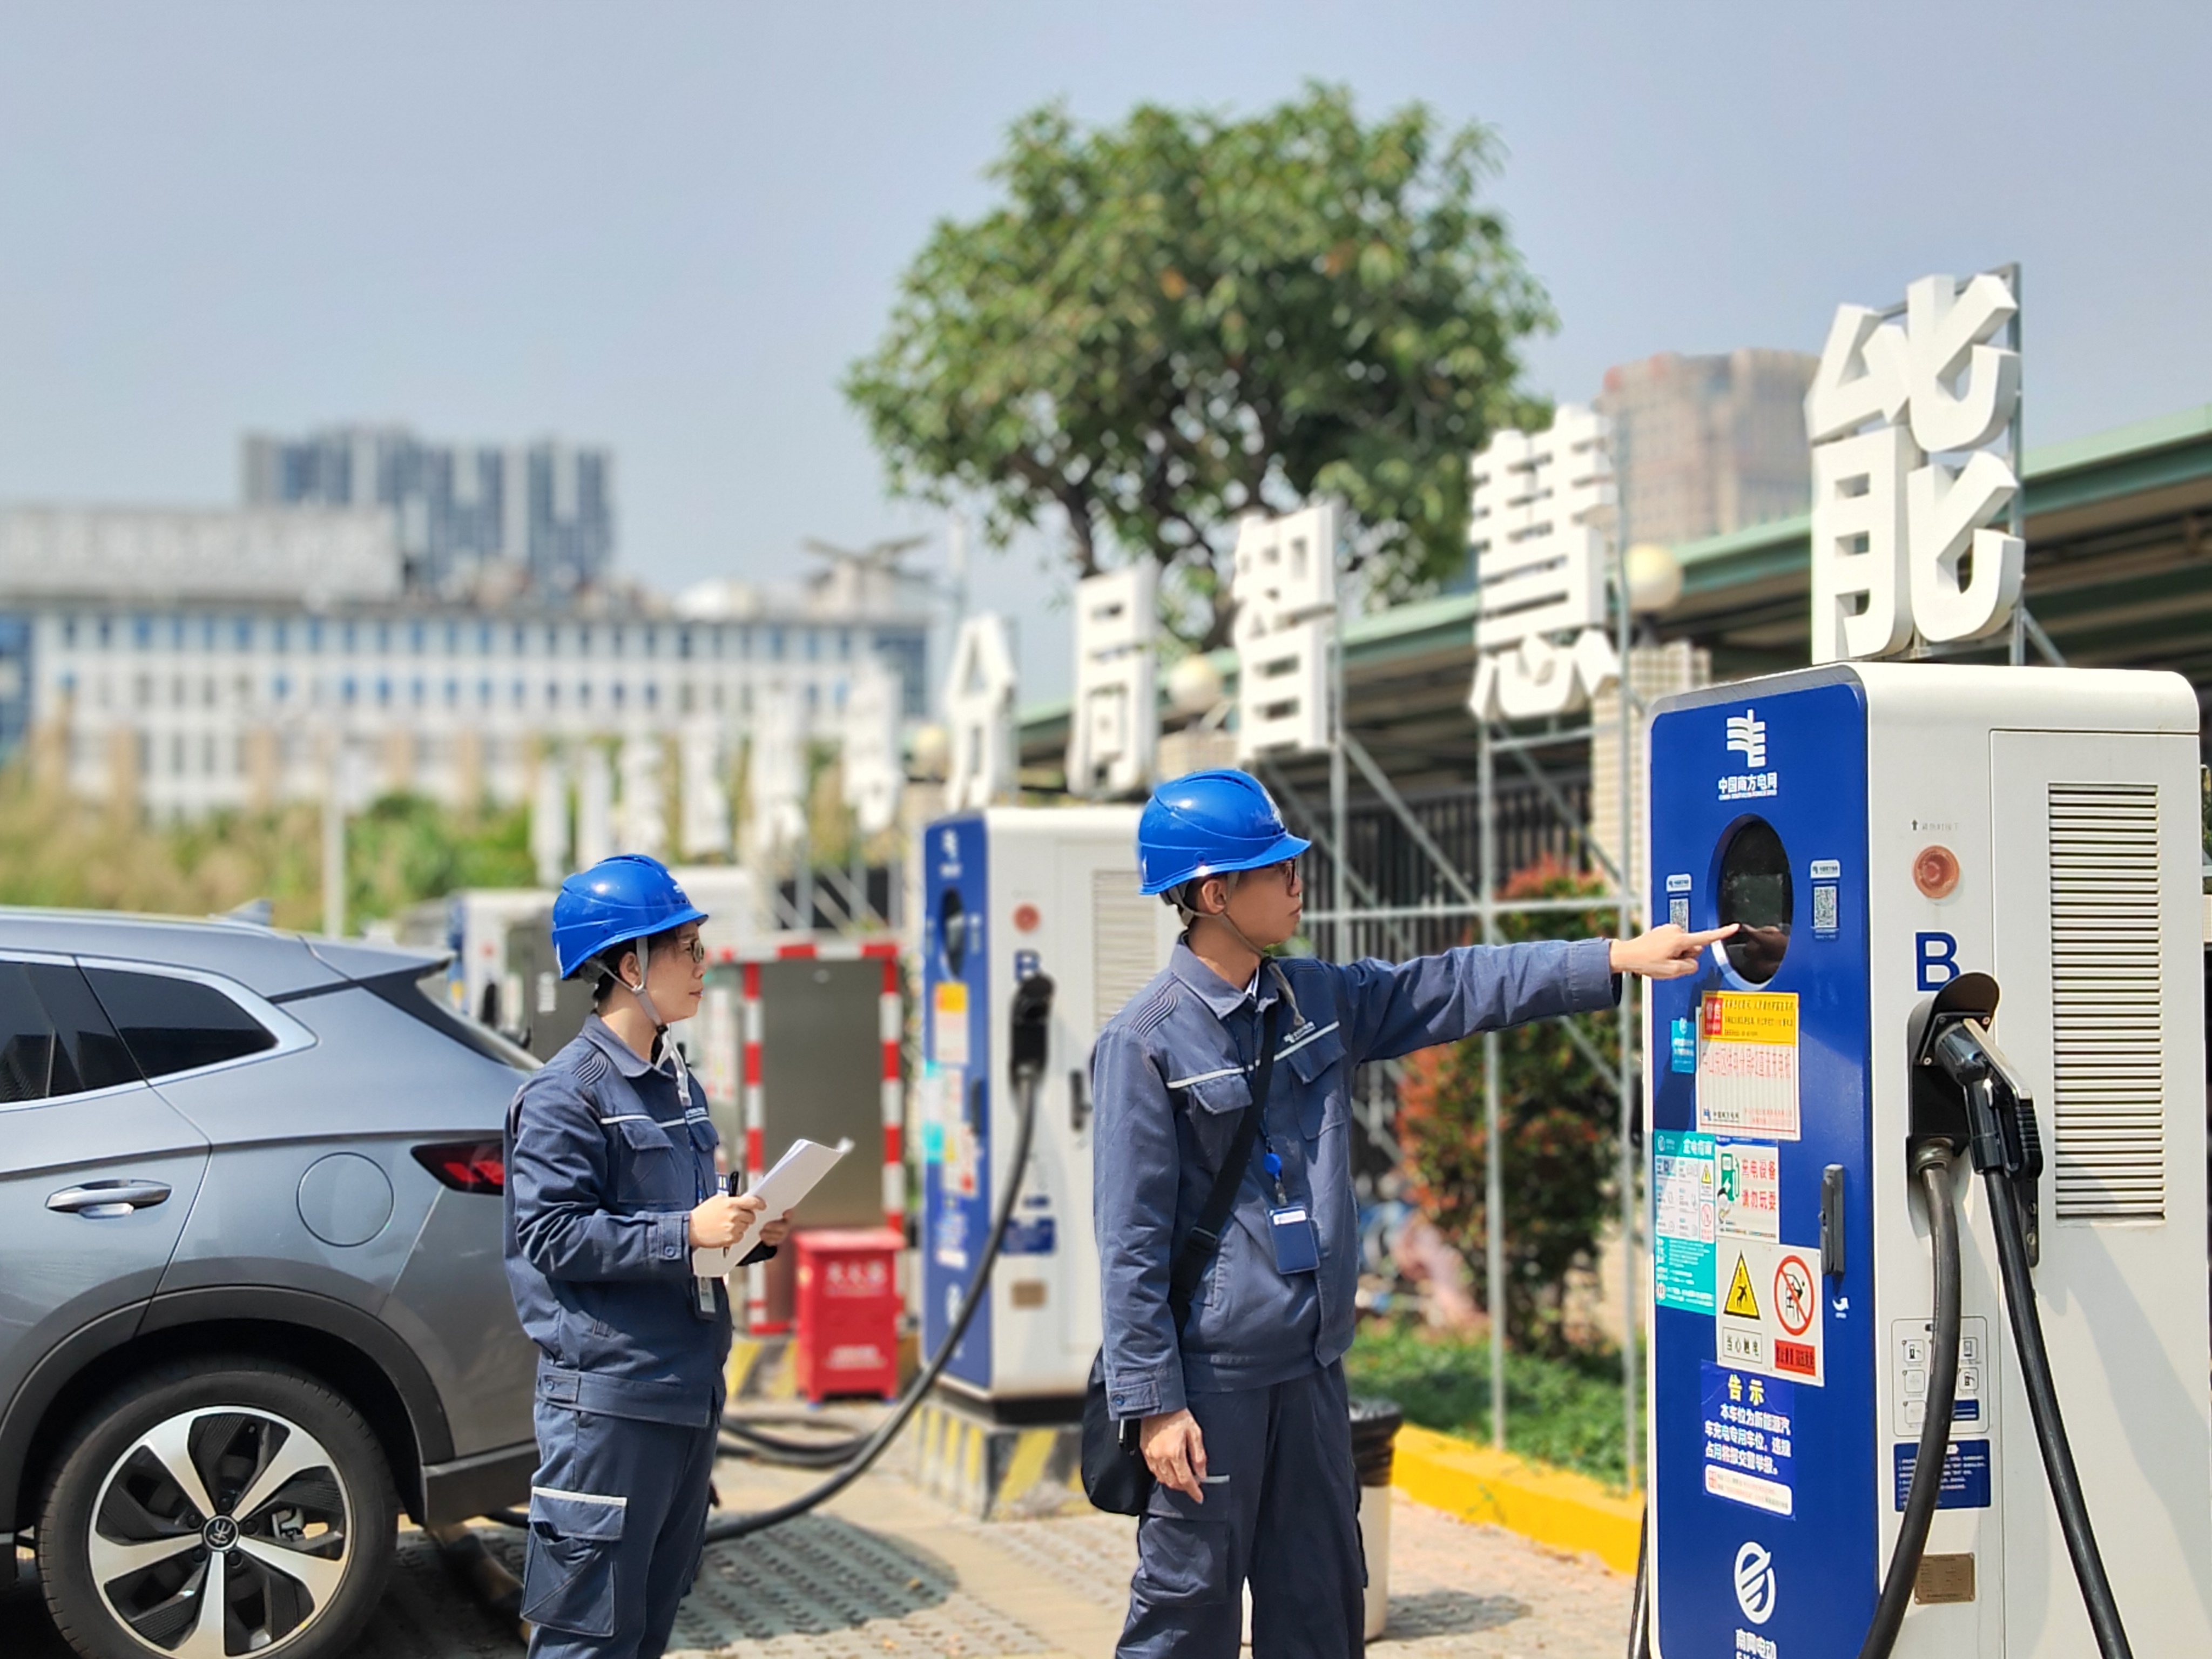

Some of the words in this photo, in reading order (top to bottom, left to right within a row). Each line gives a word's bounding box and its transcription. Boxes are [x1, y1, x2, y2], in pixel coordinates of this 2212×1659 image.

[1718, 772, 1777, 794] 中国南方电网
[1915, 932, 1960, 992] B
[1742, 1158, 1776, 1180] 充电设备
[1742, 1190, 1776, 1211] 请勿玩耍
[1727, 1335, 1759, 1356] 当心触电
[1728, 1373, 1764, 1406] 告示
